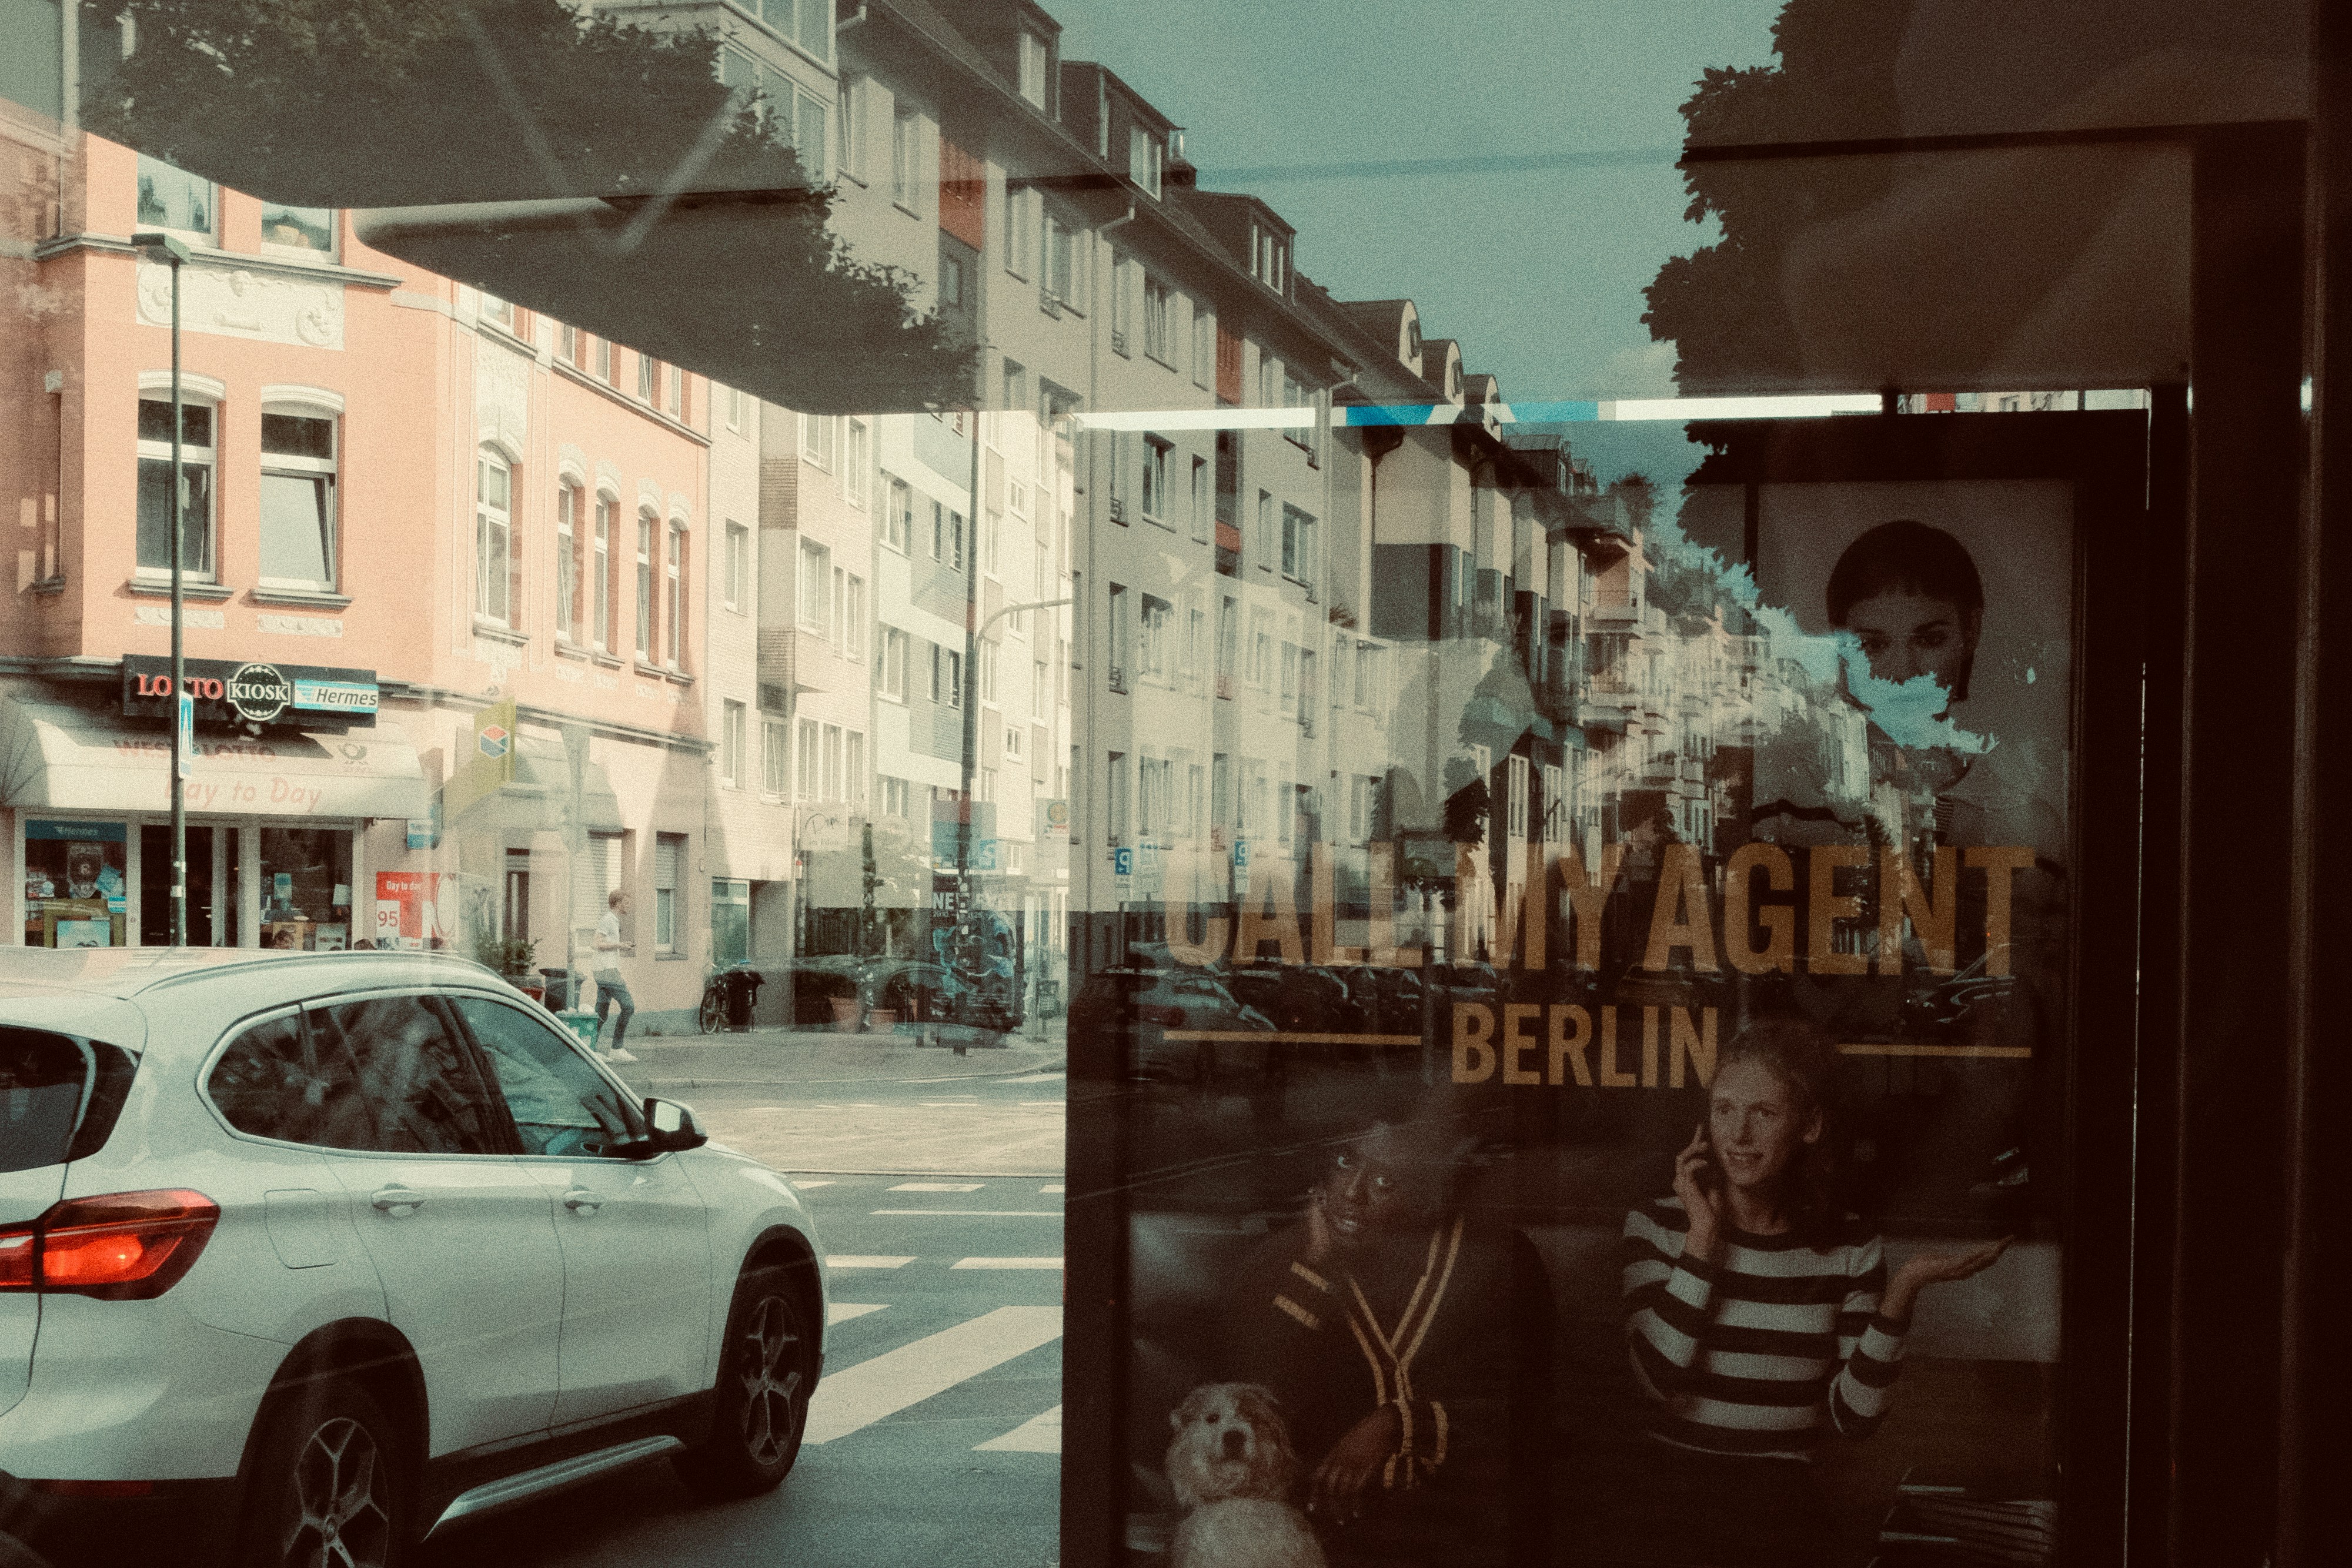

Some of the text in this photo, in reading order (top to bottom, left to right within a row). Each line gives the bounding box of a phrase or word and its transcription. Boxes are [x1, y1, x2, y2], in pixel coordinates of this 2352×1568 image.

[137, 674, 224, 700] LOTO
[230, 683, 288, 701] KIOSK
[316, 688, 377, 706] Hermes
[113, 739, 172, 758] WES
[233, 780, 257, 803] to
[270, 777, 323, 812] Day
[386, 881, 400, 892] Day
[401, 881, 409, 890] to
[377, 910, 398, 927] 95
[1164, 842, 2034, 976] CALL MY AGENT
[1452, 1002, 1719, 1089] BERLIN
